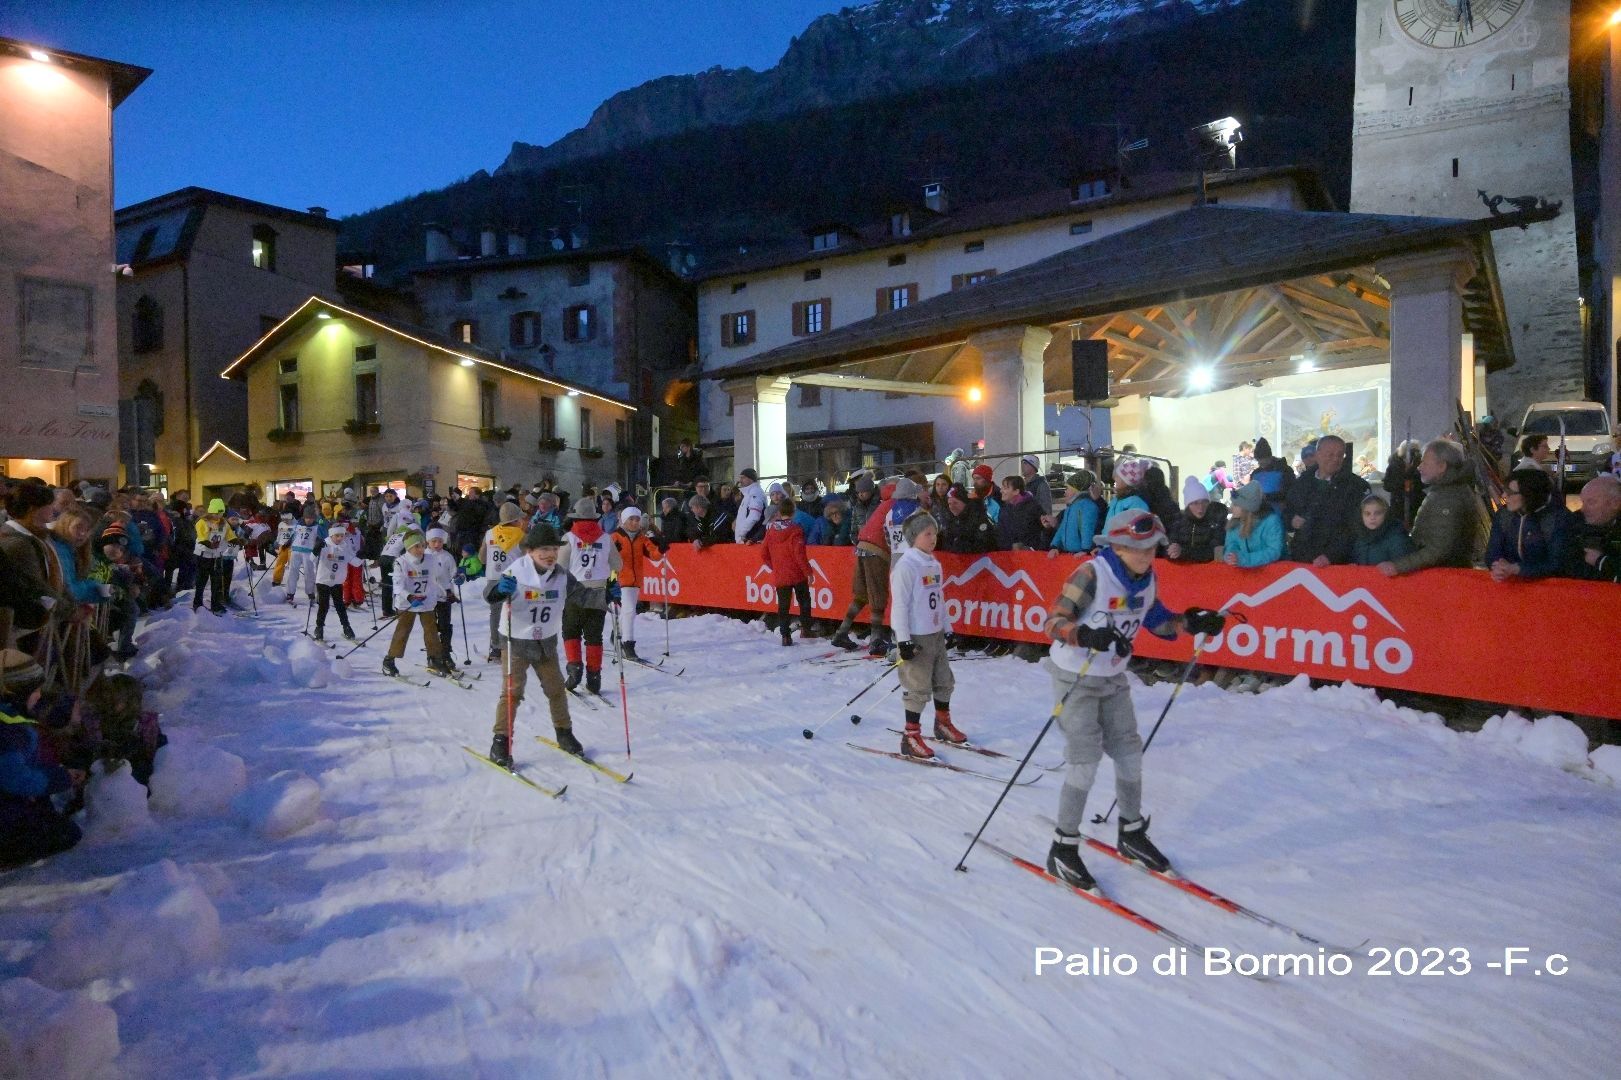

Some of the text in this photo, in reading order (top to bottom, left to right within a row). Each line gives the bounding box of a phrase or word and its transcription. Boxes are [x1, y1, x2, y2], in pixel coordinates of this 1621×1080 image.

[300, 532, 310, 540] 12
[492, 550, 507, 563] 86
[331, 563, 339, 573] 9
[413, 580, 428, 594] 27
[643, 567, 680, 597] mio
[745, 575, 833, 610] boio
[529, 606, 552, 624] 16
[943, 589, 1048, 633] ormio
